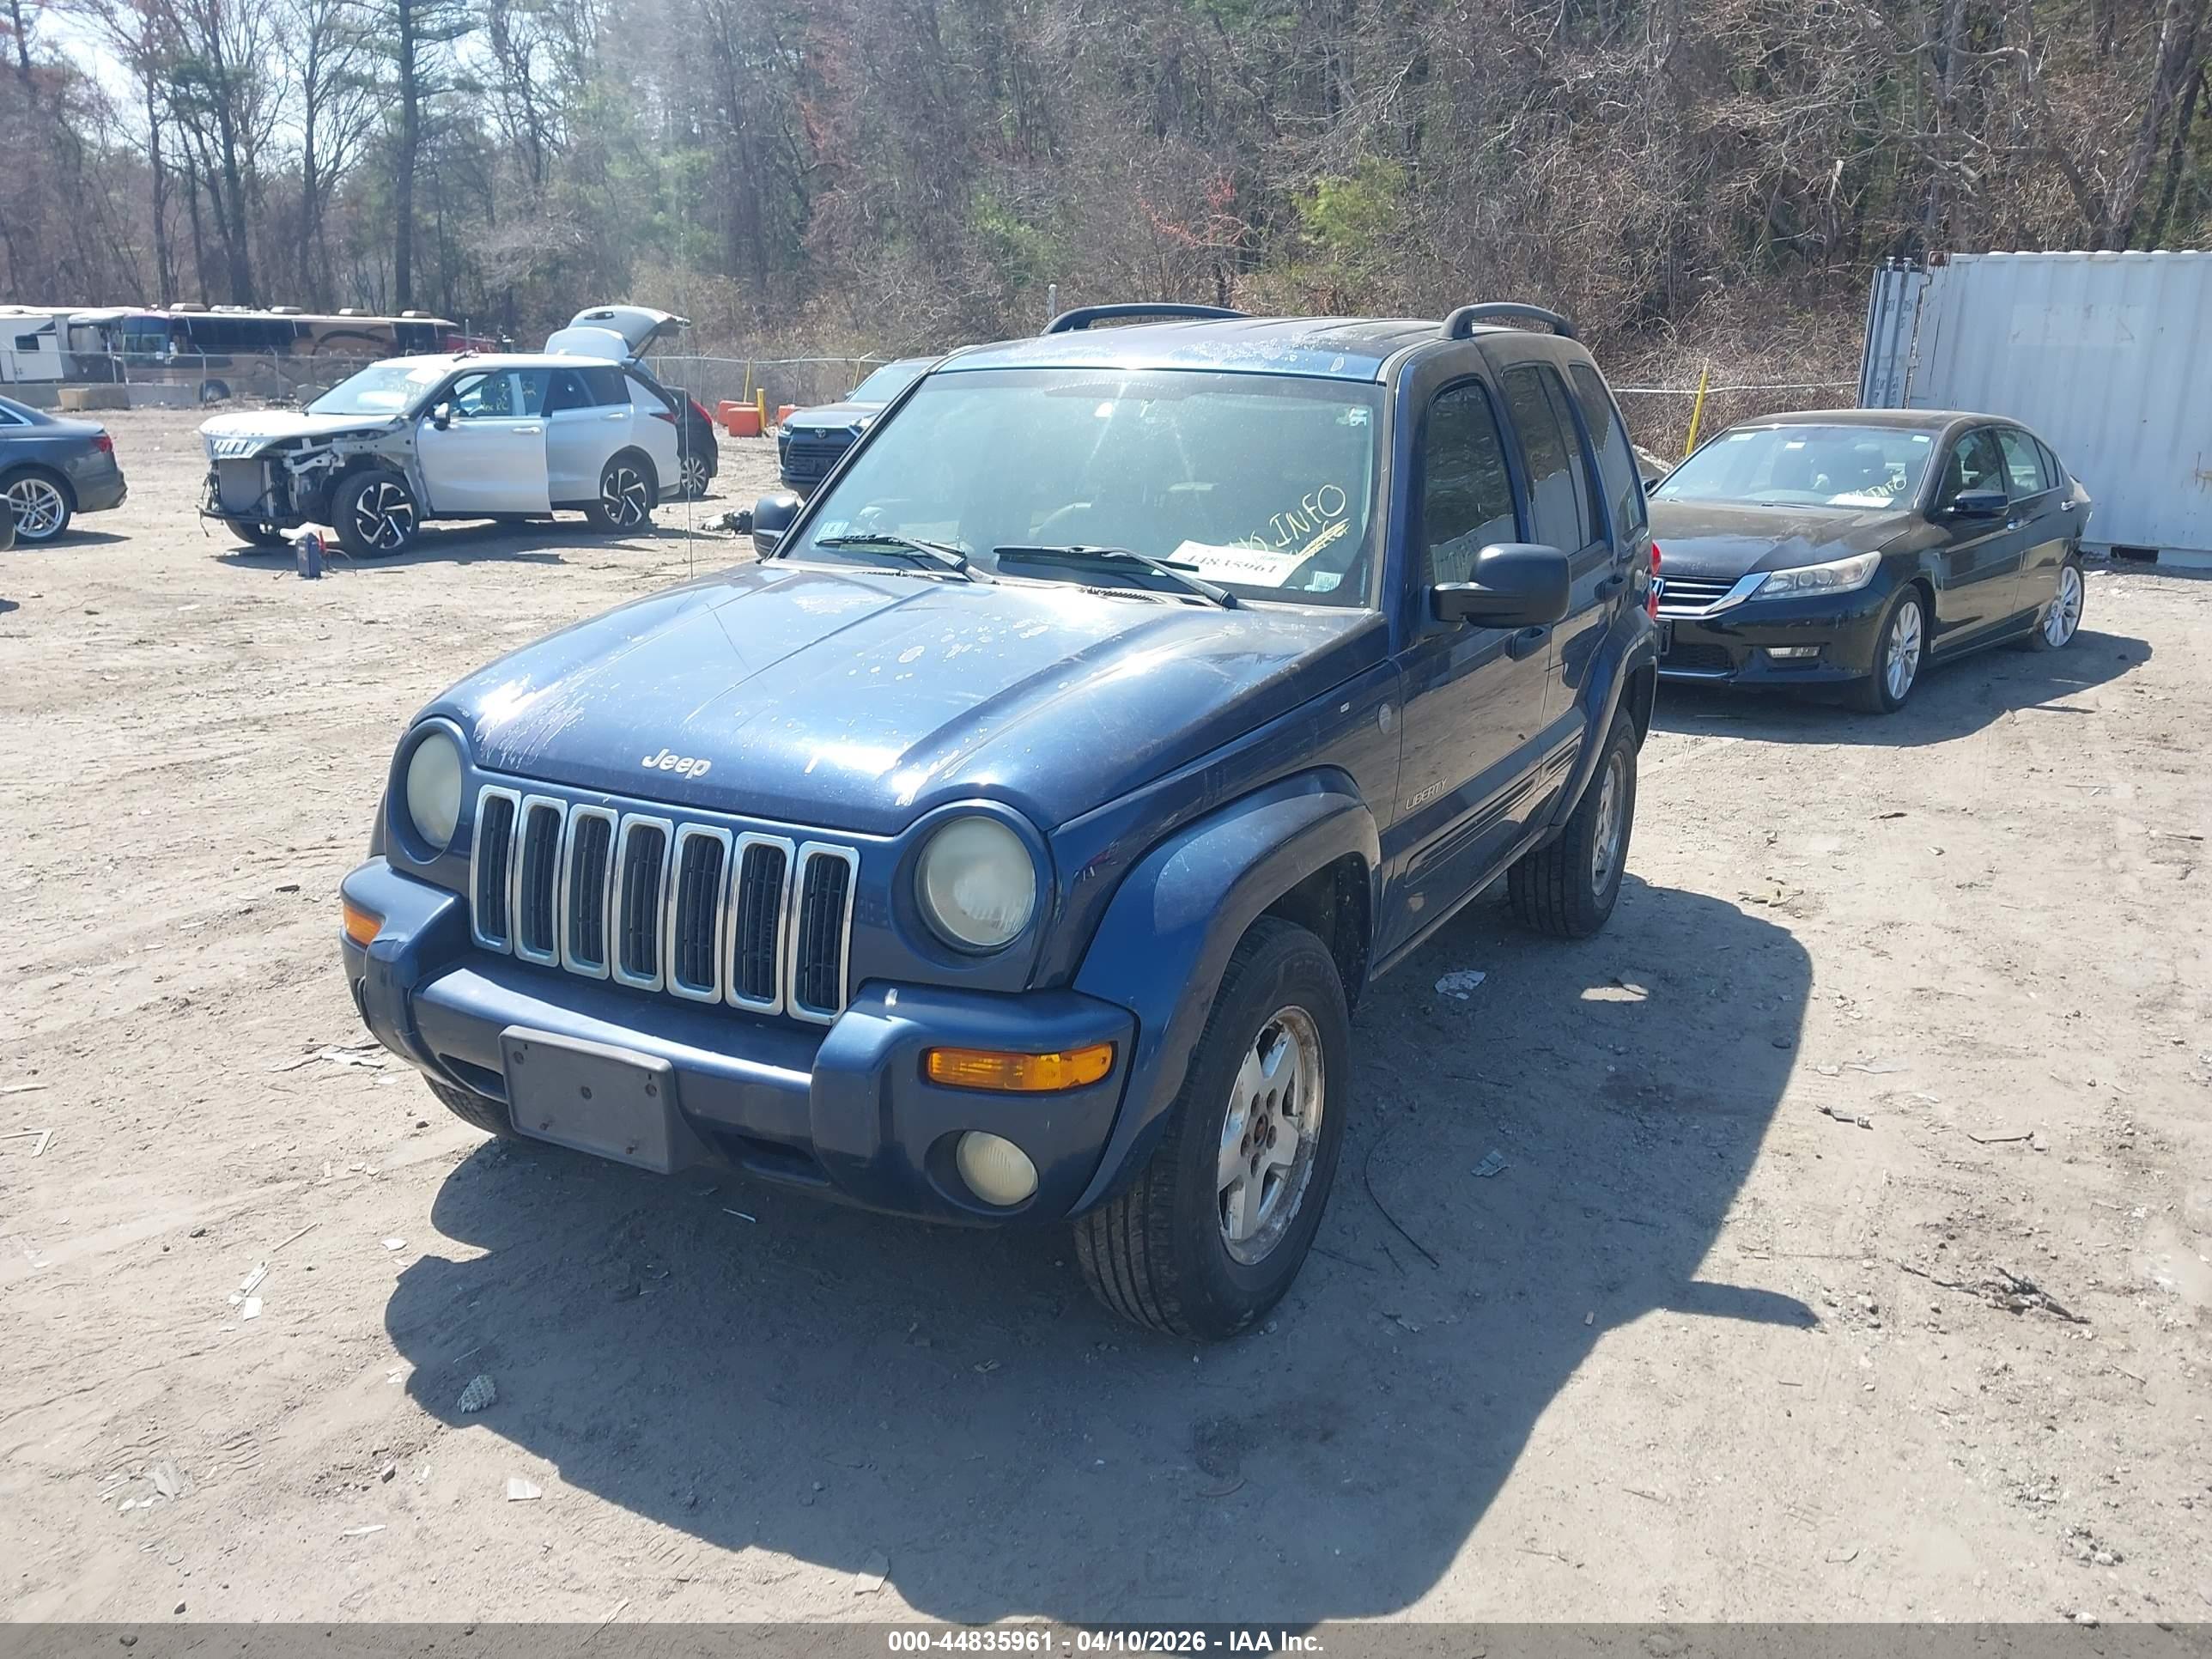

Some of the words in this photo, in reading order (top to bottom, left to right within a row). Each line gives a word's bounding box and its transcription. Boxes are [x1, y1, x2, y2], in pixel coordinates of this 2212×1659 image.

[1269, 484, 1346, 548] INFO
[641, 748, 712, 780] Jeep
[1406, 776, 1448, 810] LIBERTY
